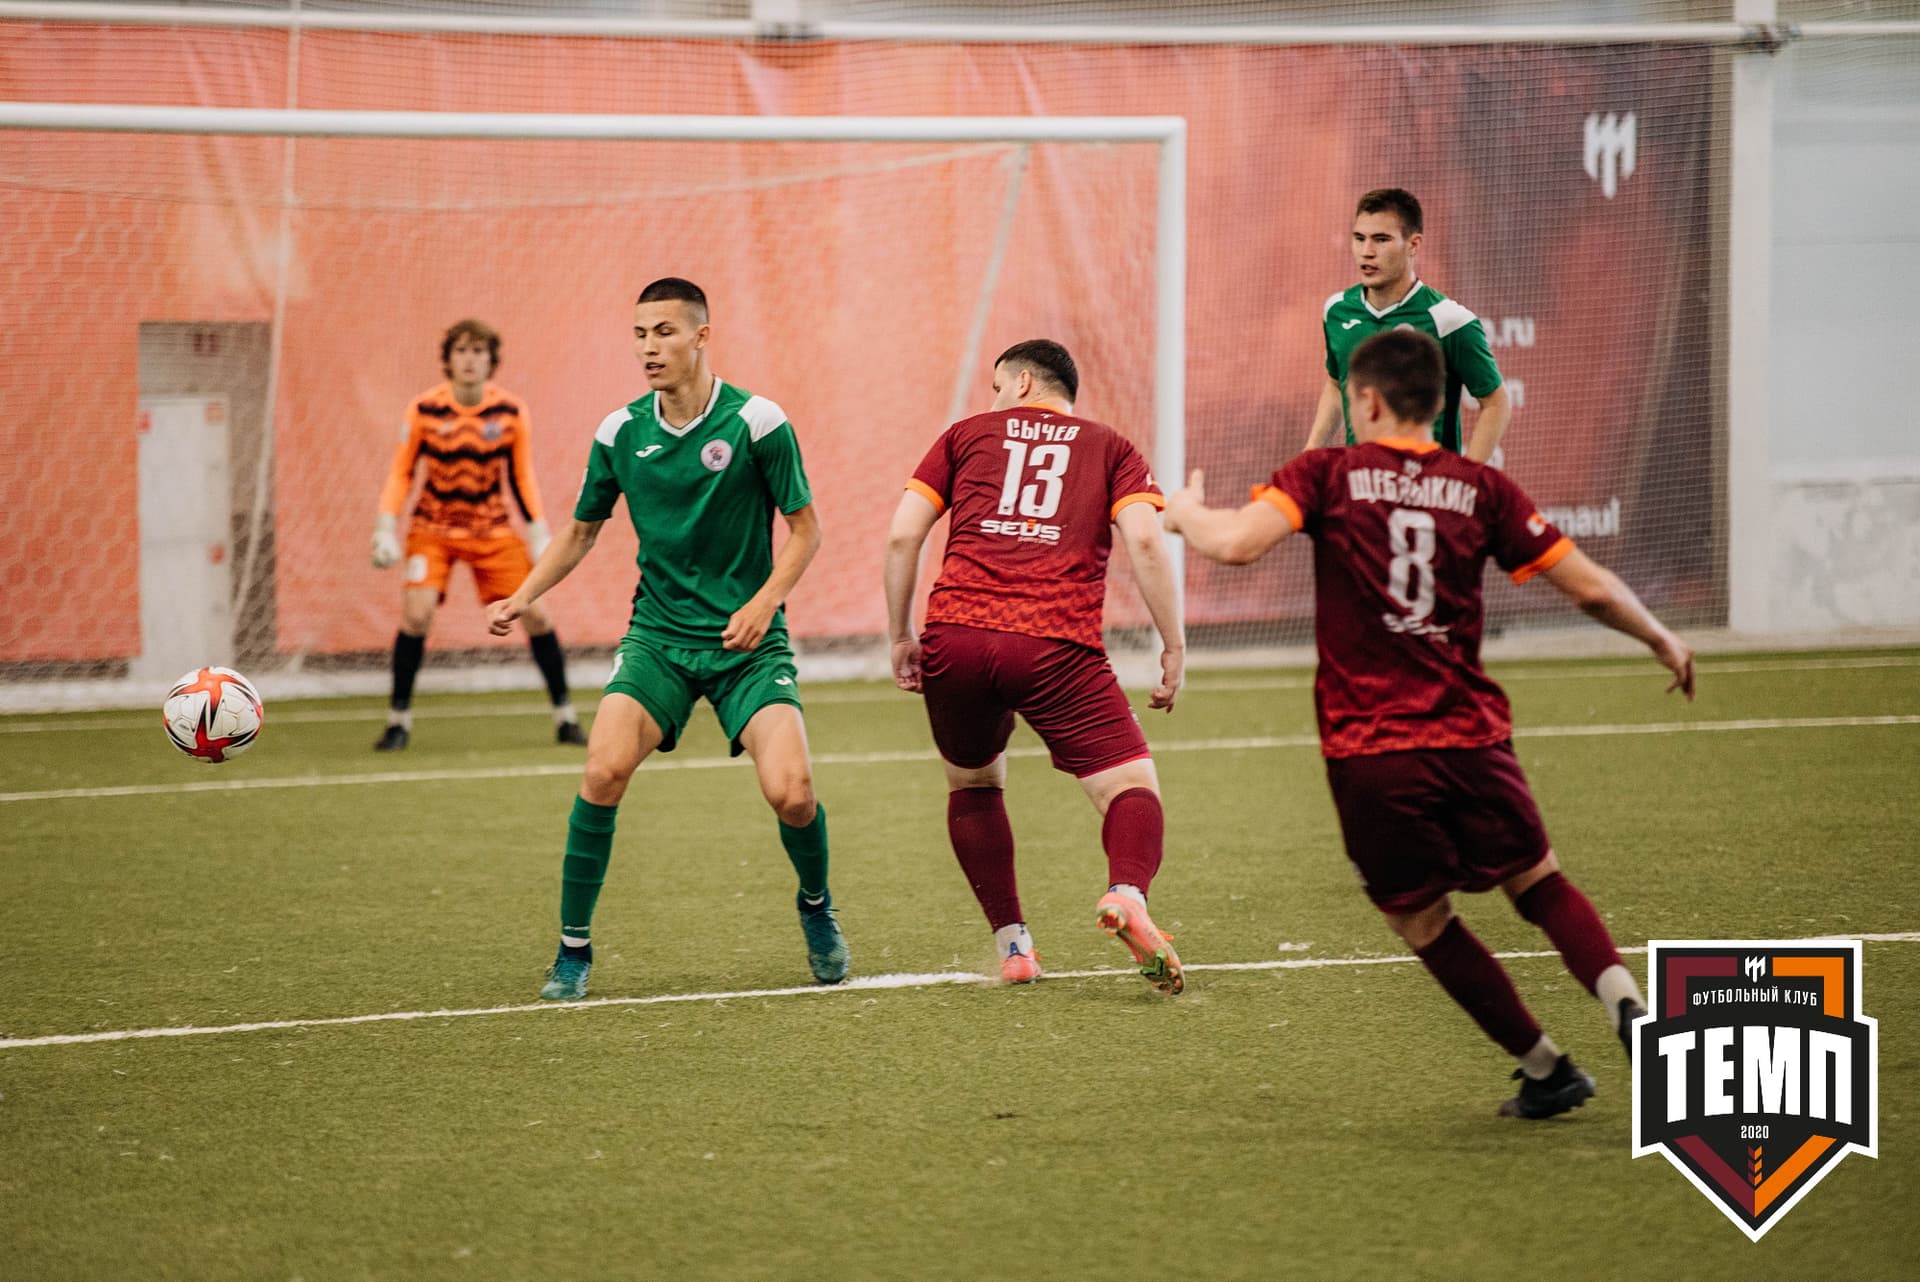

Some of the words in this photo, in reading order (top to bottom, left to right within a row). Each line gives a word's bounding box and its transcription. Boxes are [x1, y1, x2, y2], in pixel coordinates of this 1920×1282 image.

[1006, 418, 1080, 441] СЫЧЕВ
[997, 439, 1071, 519] 13
[980, 519, 1061, 540] SEUS
[1387, 508, 1436, 619] 8
